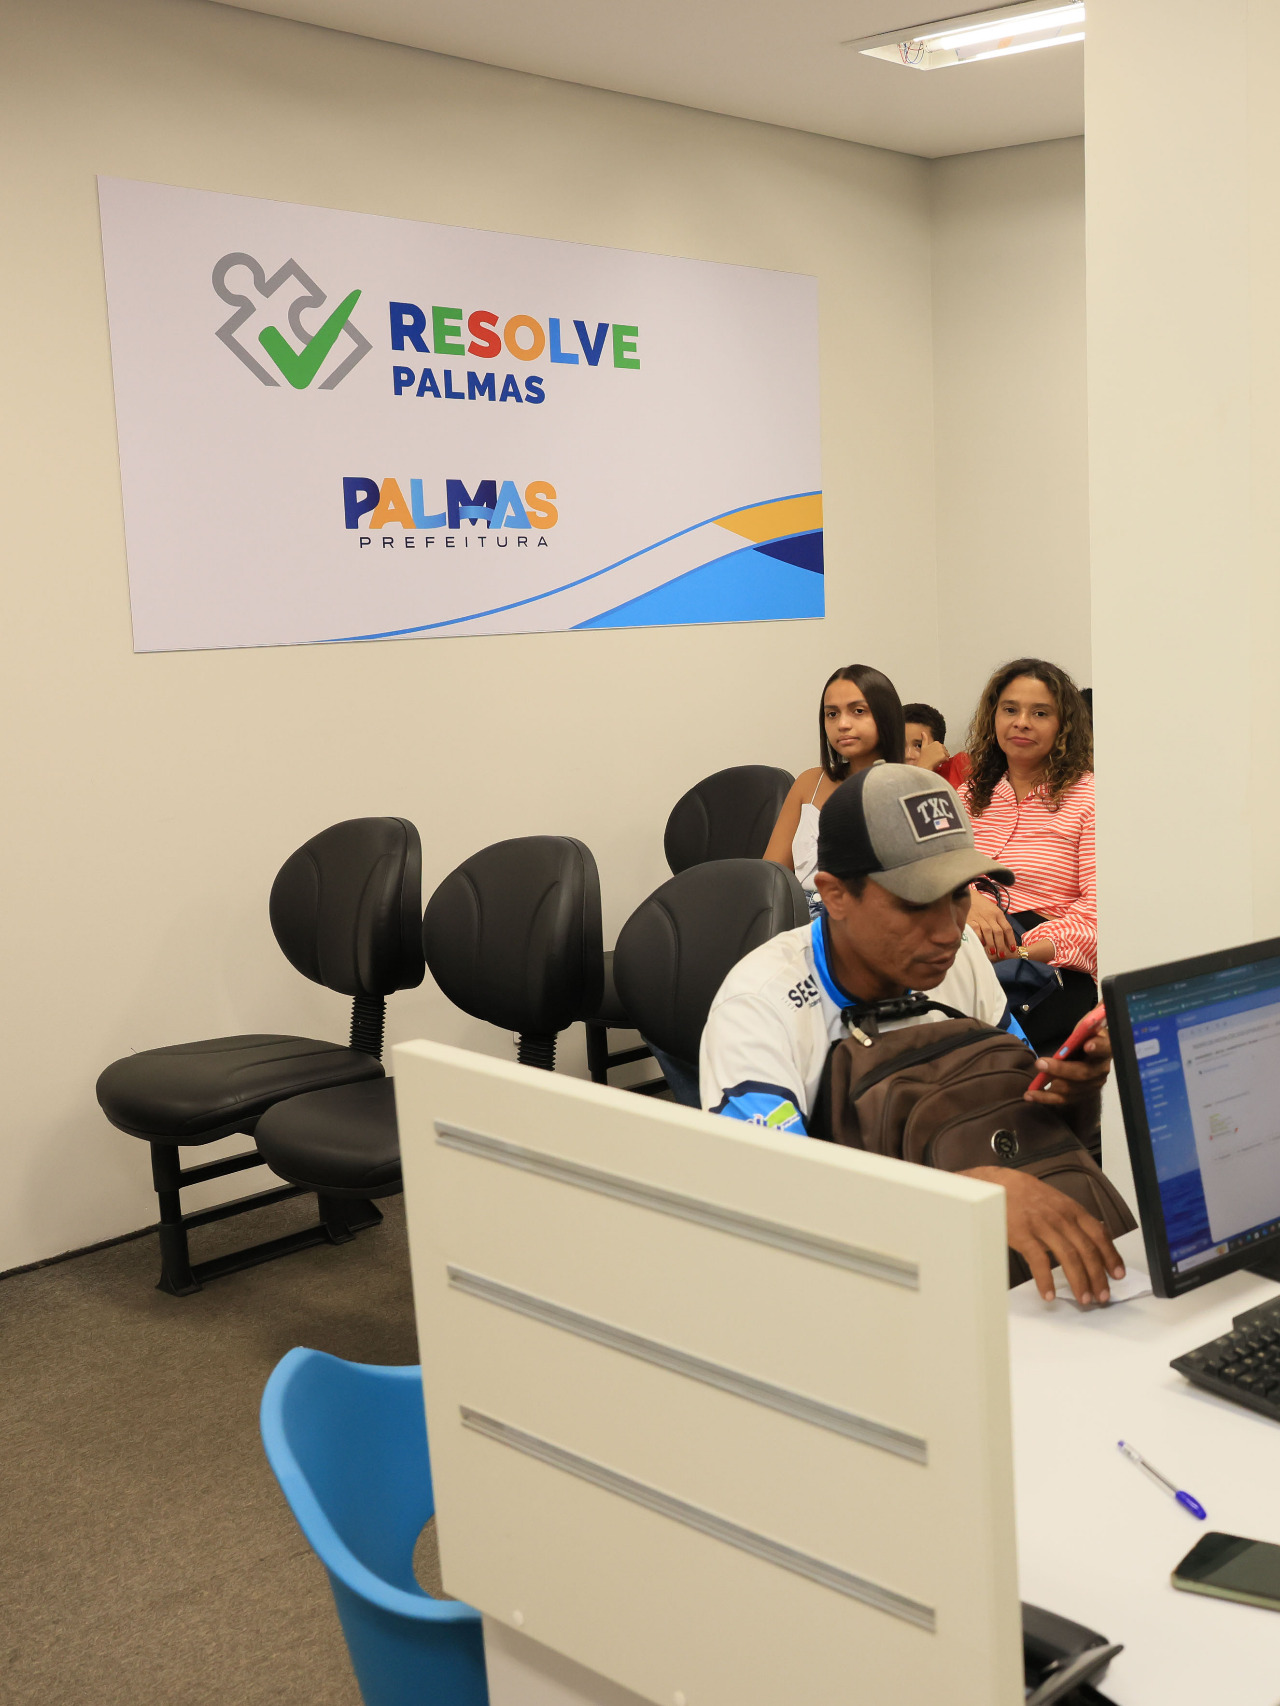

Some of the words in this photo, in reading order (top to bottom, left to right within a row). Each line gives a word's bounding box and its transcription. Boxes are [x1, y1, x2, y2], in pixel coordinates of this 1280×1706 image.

[389, 301, 641, 370] RESOLVE
[392, 365, 546, 404] PALMAS
[342, 476, 559, 530] PALMAS
[359, 535, 549, 549] PREFEITURA
[916, 797, 955, 824] TXC
